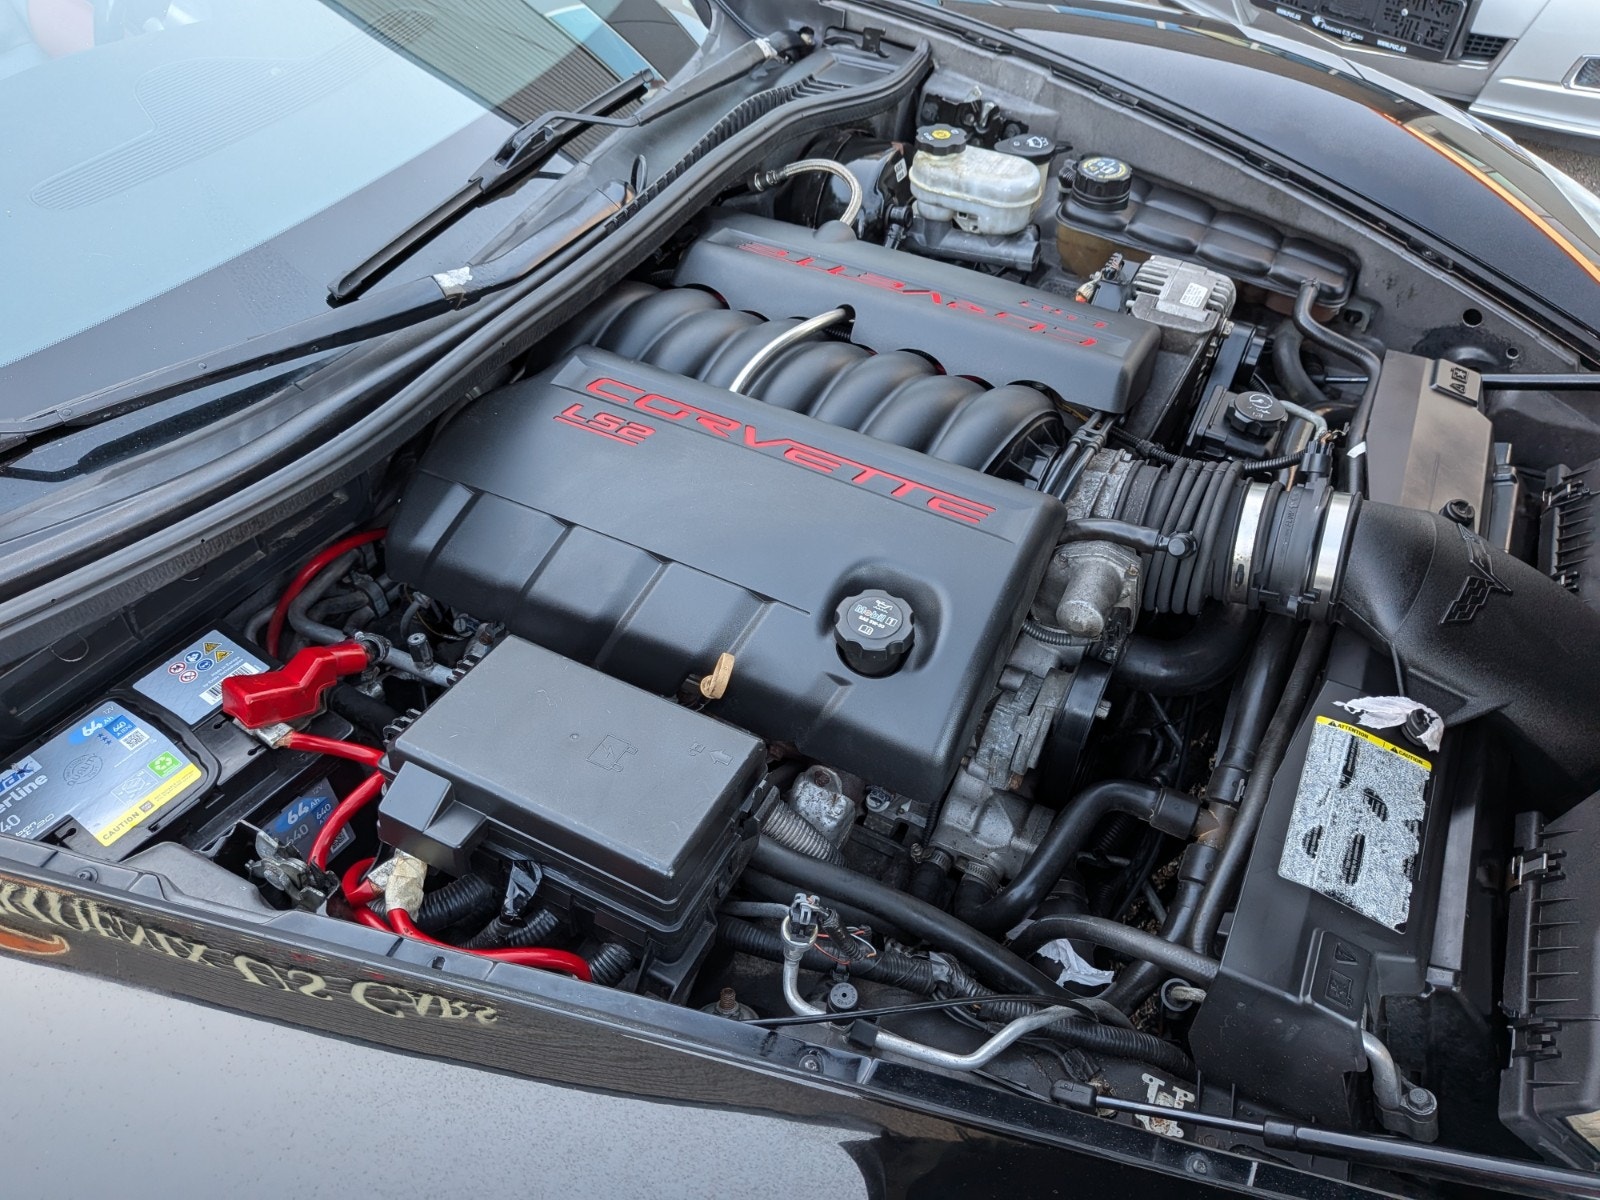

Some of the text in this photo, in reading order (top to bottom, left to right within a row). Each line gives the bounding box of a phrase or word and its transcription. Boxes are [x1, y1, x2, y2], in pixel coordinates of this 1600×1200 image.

[562, 402, 657, 443] LS2
[585, 377, 997, 524] CORVETTE
[854, 604, 887, 622] Mobil
[103, 706, 115, 715] 12V
[82, 720, 103, 737] 64
[112, 721, 127, 732] 640
[1337, 723, 1369, 740] ATTENTION
[1398, 750, 1424, 765] CAUTION
[67, 752, 98, 787] QUALITY
[287, 802, 310, 825] 64
[310, 798, 321, 808] Ah
[316, 803, 332, 820] 640
[102, 811, 140, 841] CAUTION
